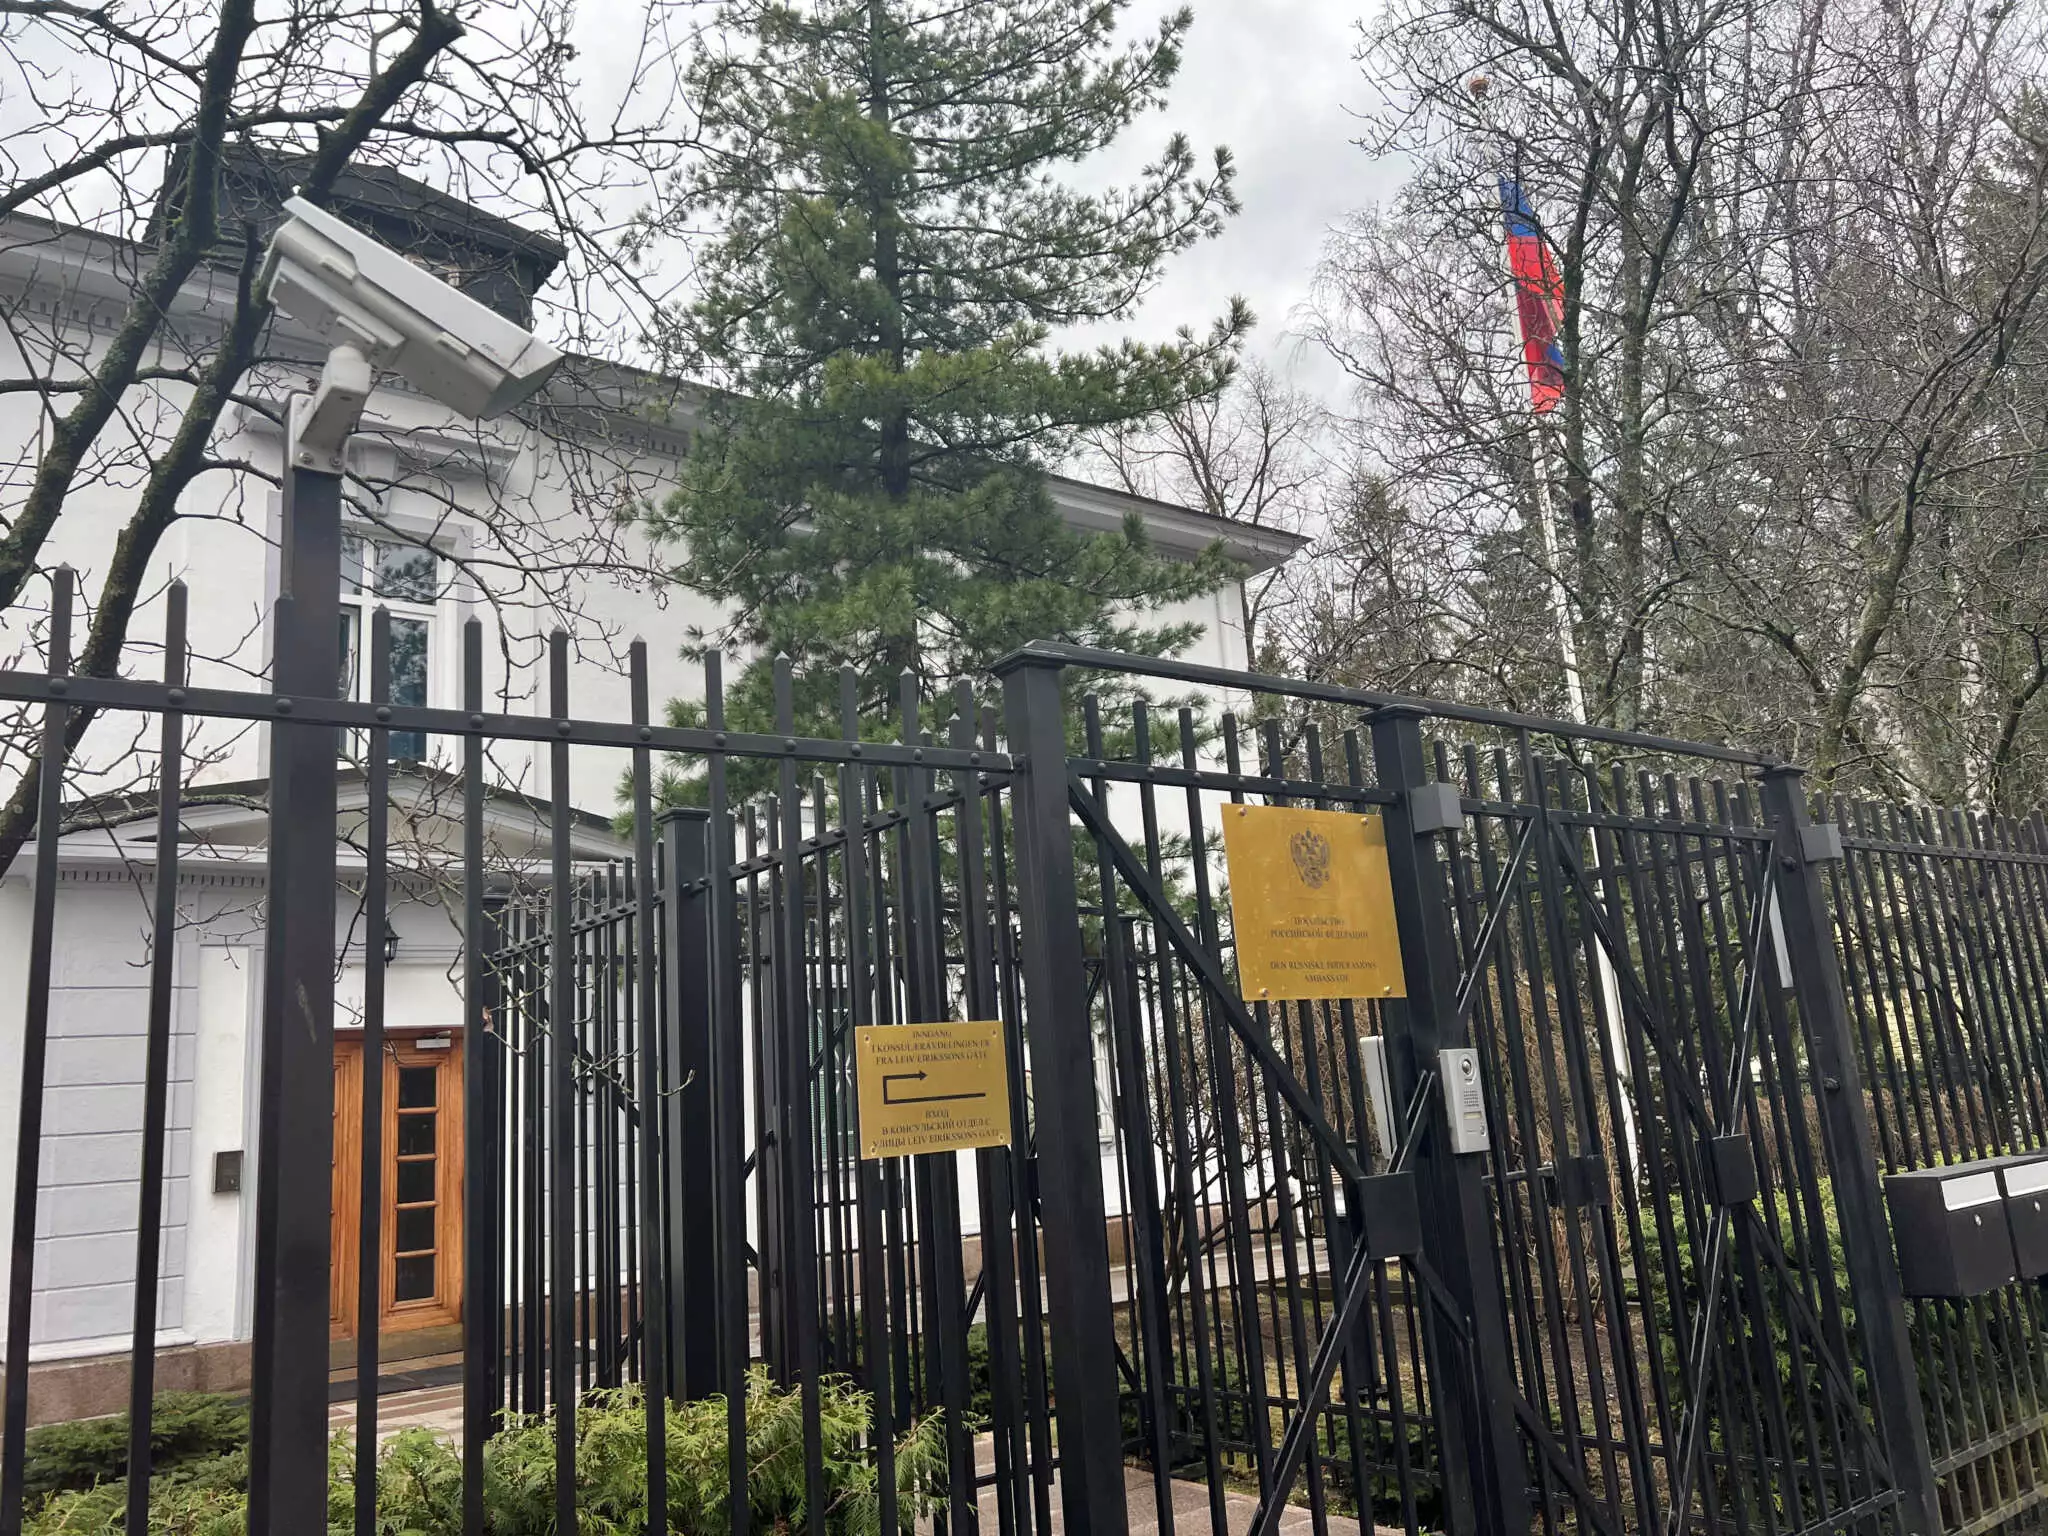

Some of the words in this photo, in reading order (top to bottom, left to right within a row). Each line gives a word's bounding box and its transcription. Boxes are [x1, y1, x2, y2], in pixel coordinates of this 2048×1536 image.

[1270, 927, 1323, 938] РОССИЙСКОЙ
[1325, 929, 1369, 939] ФЕДЕРАЦИИ
[1270, 960, 1287, 970] DEN
[1288, 960, 1324, 970] RUSSISKE
[1304, 974, 1349, 983] AMBASSADE
[876, 1056, 893, 1065] FRA
[895, 1055, 914, 1064] LEIV
[917, 1052, 965, 1063] EIRIKSSONS
[966, 1051, 987, 1060] GATE
[925, 1110, 949, 1119] ВХОД
[882, 1127, 888, 1135] В
[890, 1119, 955, 1134] КОНСУЛЬСКИЙ
[955, 1119, 984, 1129] ОТДЕЛ
[985, 1118, 992, 1126] С
[873, 1138, 906, 1148] УЛИЦЫ
[907, 1136, 928, 1146] LEIV
[929, 1131, 978, 1144] EIRIKSSONS
[978, 1128, 1002, 1139] GATE
